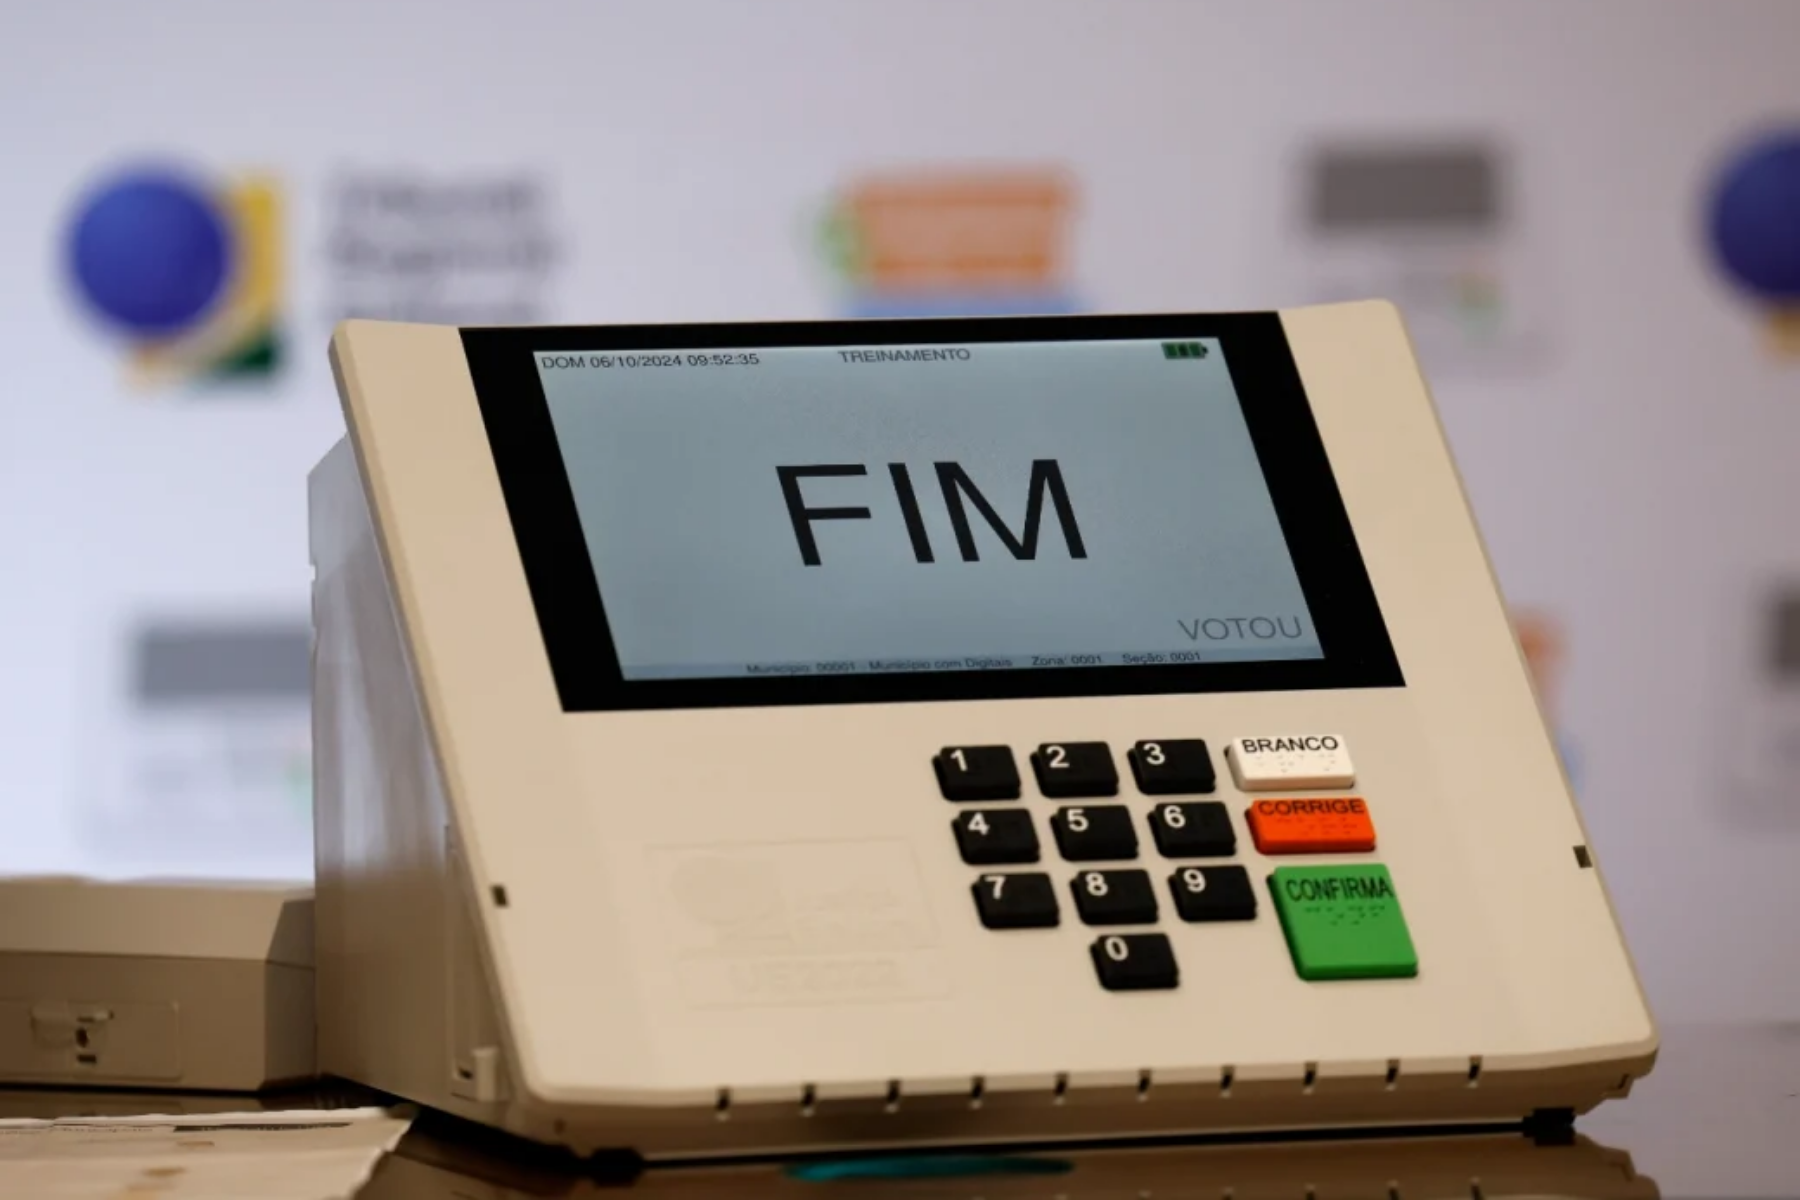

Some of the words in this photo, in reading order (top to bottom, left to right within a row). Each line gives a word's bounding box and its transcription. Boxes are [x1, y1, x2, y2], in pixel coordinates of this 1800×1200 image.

[541, 356, 586, 369] DOM
[589, 354, 682, 369] 06/10/2024
[686, 353, 760, 368] 09:52:35
[838, 348, 971, 363] TREINAMENTO
[775, 458, 1088, 567] FIM
[1177, 615, 1302, 642] VOTOU
[934, 659, 962, 669] com
[964, 656, 1014, 671] Digitais
[1031, 654, 1068, 667] Zona:
[1070, 653, 1102, 665] 0001
[1121, 651, 1168, 666] Seção:
[1169, 650, 1201, 662] 0001
[1143, 742, 1166, 765] 3
[1241, 736, 1339, 753] BRANCO
[950, 749, 967, 772] 1
[1046, 745, 1070, 769] 2
[1164, 805, 1186, 829] 6
[1258, 799, 1365, 815] CORRIGE
[968, 812, 989, 835] 4
[1067, 808, 1089, 832] 5
[984, 875, 1006, 899] 7
[1085, 872, 1108, 896] 8
[1184, 868, 1206, 893] 9
[1285, 876, 1394, 902] CONFIRMA
[1105, 936, 1129, 961] 0
